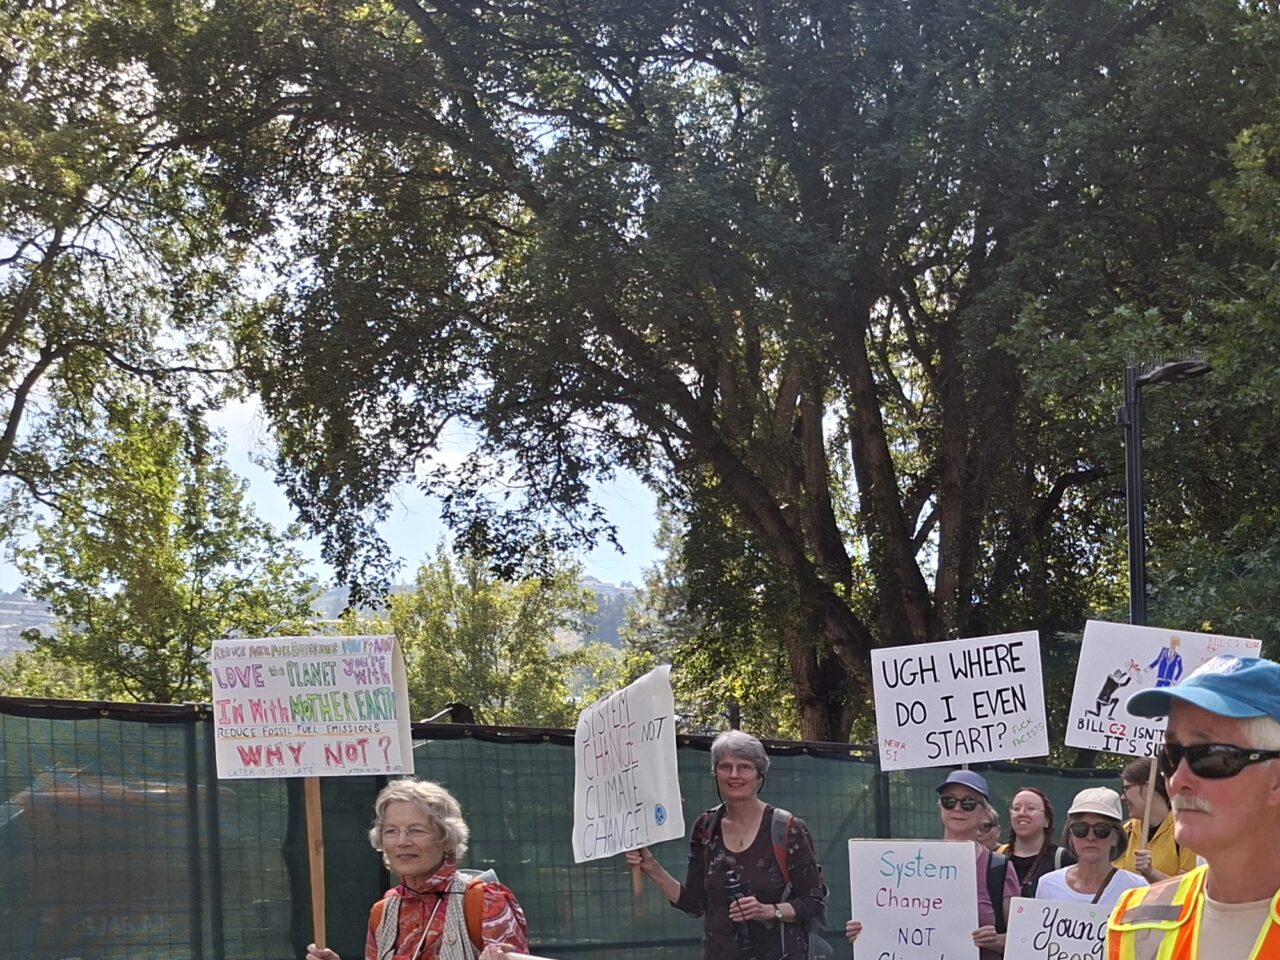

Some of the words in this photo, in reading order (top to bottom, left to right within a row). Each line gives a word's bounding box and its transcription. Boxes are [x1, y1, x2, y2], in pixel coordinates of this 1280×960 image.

[214, 663, 265, 689] LOVE
[286, 660, 337, 687] PLANET
[949, 641, 1026, 680] WHERE
[289, 690, 357, 722] MOTHER
[895, 700, 927, 727] DO
[940, 695, 957, 723] I
[973, 684, 1027, 719] EVEN
[217, 726, 256, 738] REDUCE
[262, 726, 293, 737] FOSSIL
[297, 725, 318, 735] FUEL
[326, 724, 381, 734] EMISSIONS
[925, 722, 1007, 760] START?
[1077, 718, 1105, 733] BILL
[1133, 726, 1165, 742] ISN'T
[1102, 734, 1137, 753] IT'S
[236, 741, 307, 768] WHY
[583, 721, 639, 781] CHANGE
[641, 716, 668, 743] NOT
[585, 764, 643, 821] CLIMATE
[583, 806, 650, 858] CHANGE!
[879, 848, 958, 888] System
[875, 887, 943, 916] Change
[898, 928, 936, 946] NOT
